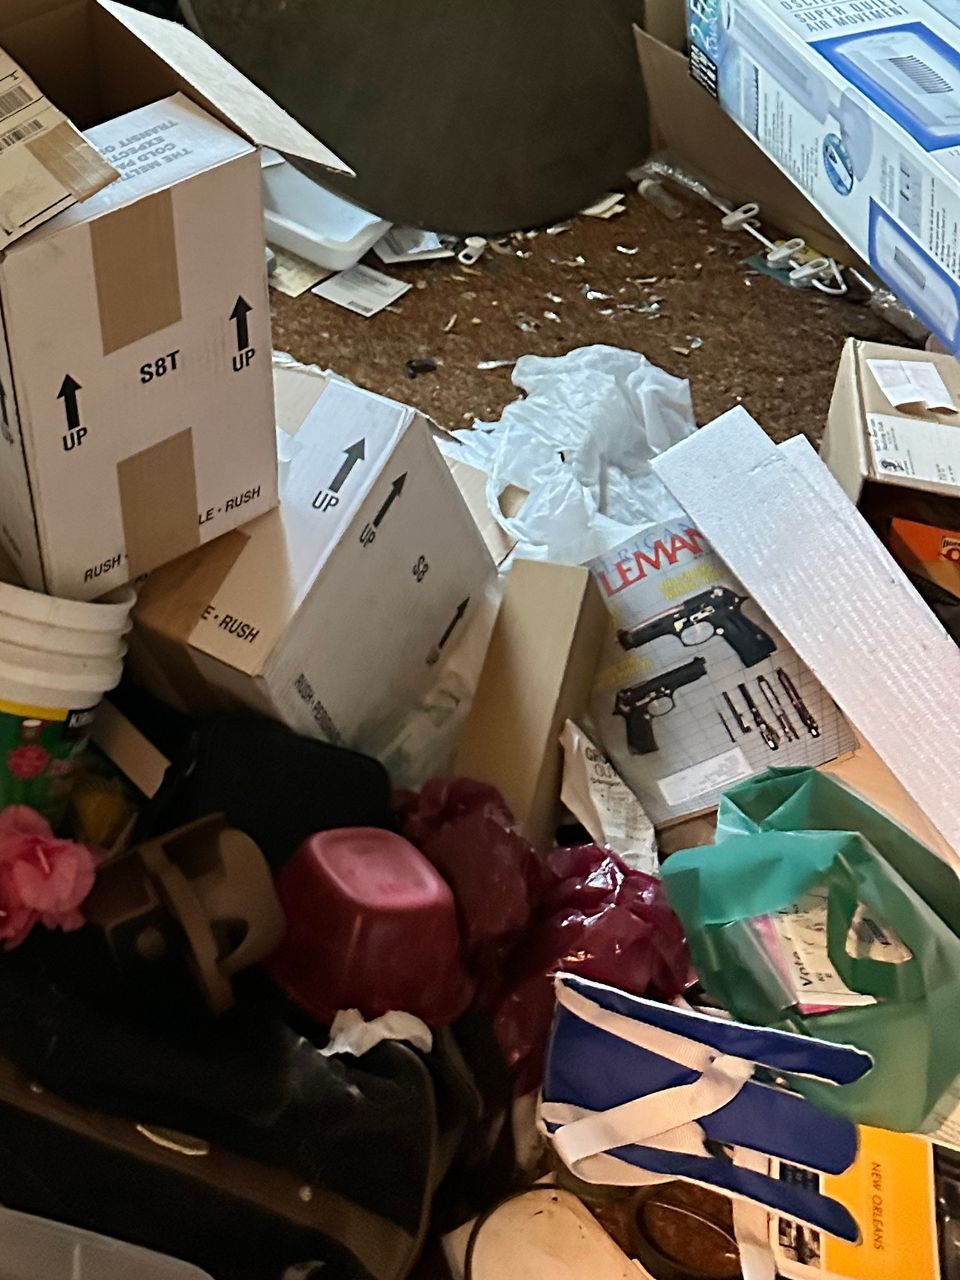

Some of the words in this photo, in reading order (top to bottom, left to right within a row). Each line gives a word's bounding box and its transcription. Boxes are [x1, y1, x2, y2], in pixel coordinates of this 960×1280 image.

[793, 6, 845, 24] SUPER
[806, 18, 832, 33] AIR
[832, 4, 911, 28] MOVEMENT
[690, 24, 710, 51] 2
[117, 120, 180, 148] TRANSIT
[109, 135, 167, 163] EXPECT
[137, 142, 177, 161] COLD
[161, 148, 194, 164] THE
[139, 350, 181, 385] S8T
[231, 348, 257, 373] UP
[61, 426, 88, 453] UP
[311, 489, 340, 513] UP
[83, 553, 122, 584] RUSH
[224, 485, 262, 513] RUSH
[358, 522, 378, 549] UP
[218, 614, 261, 644] RUSH
[871, 1161, 881, 1189] NEW
[871, 1194, 885, 1250] ORLEANS
